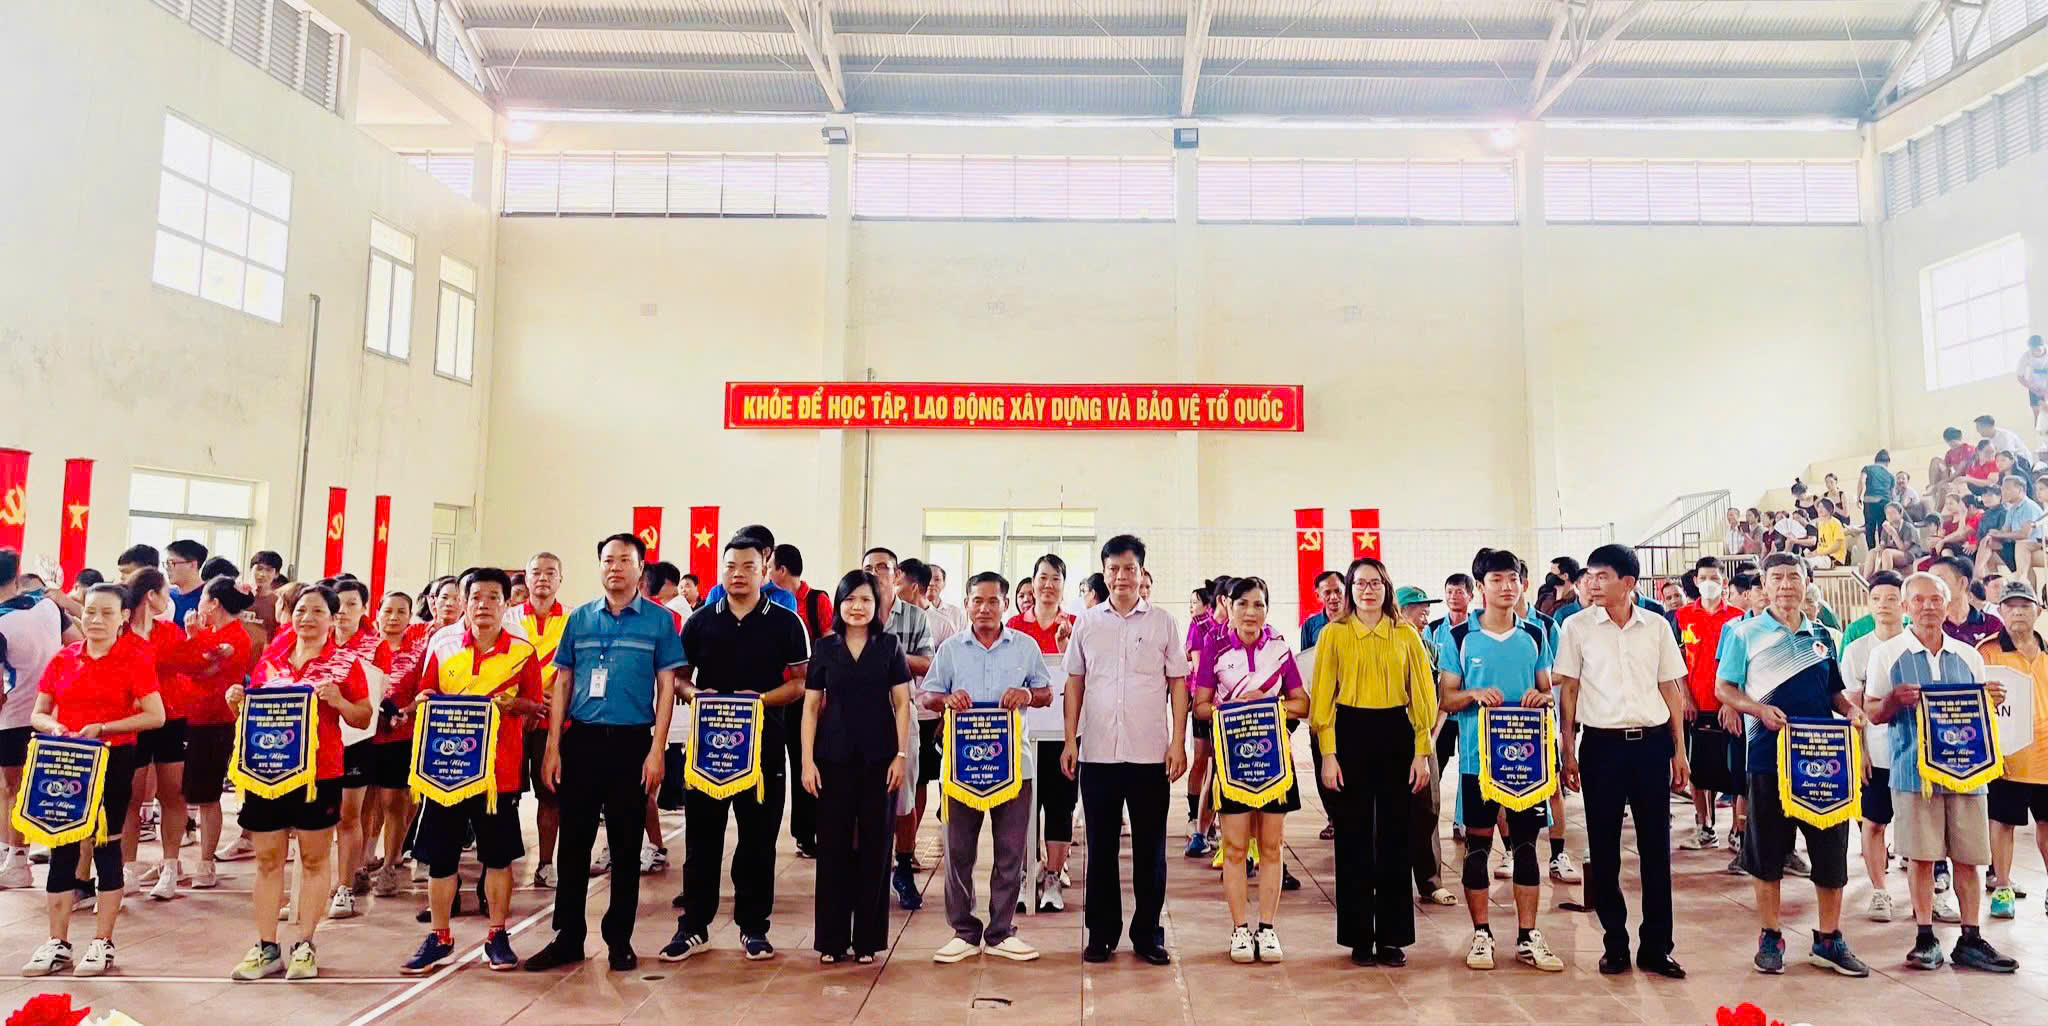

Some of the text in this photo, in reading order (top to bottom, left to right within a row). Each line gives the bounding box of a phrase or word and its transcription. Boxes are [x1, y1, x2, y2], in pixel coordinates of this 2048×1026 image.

[744, 386, 1283, 426] KHỎE ĐỂ HỌC TẬP, LAO ĐỘNG XÂY DỰNG VÀ BẢO VỆ TỔ QUỐC
